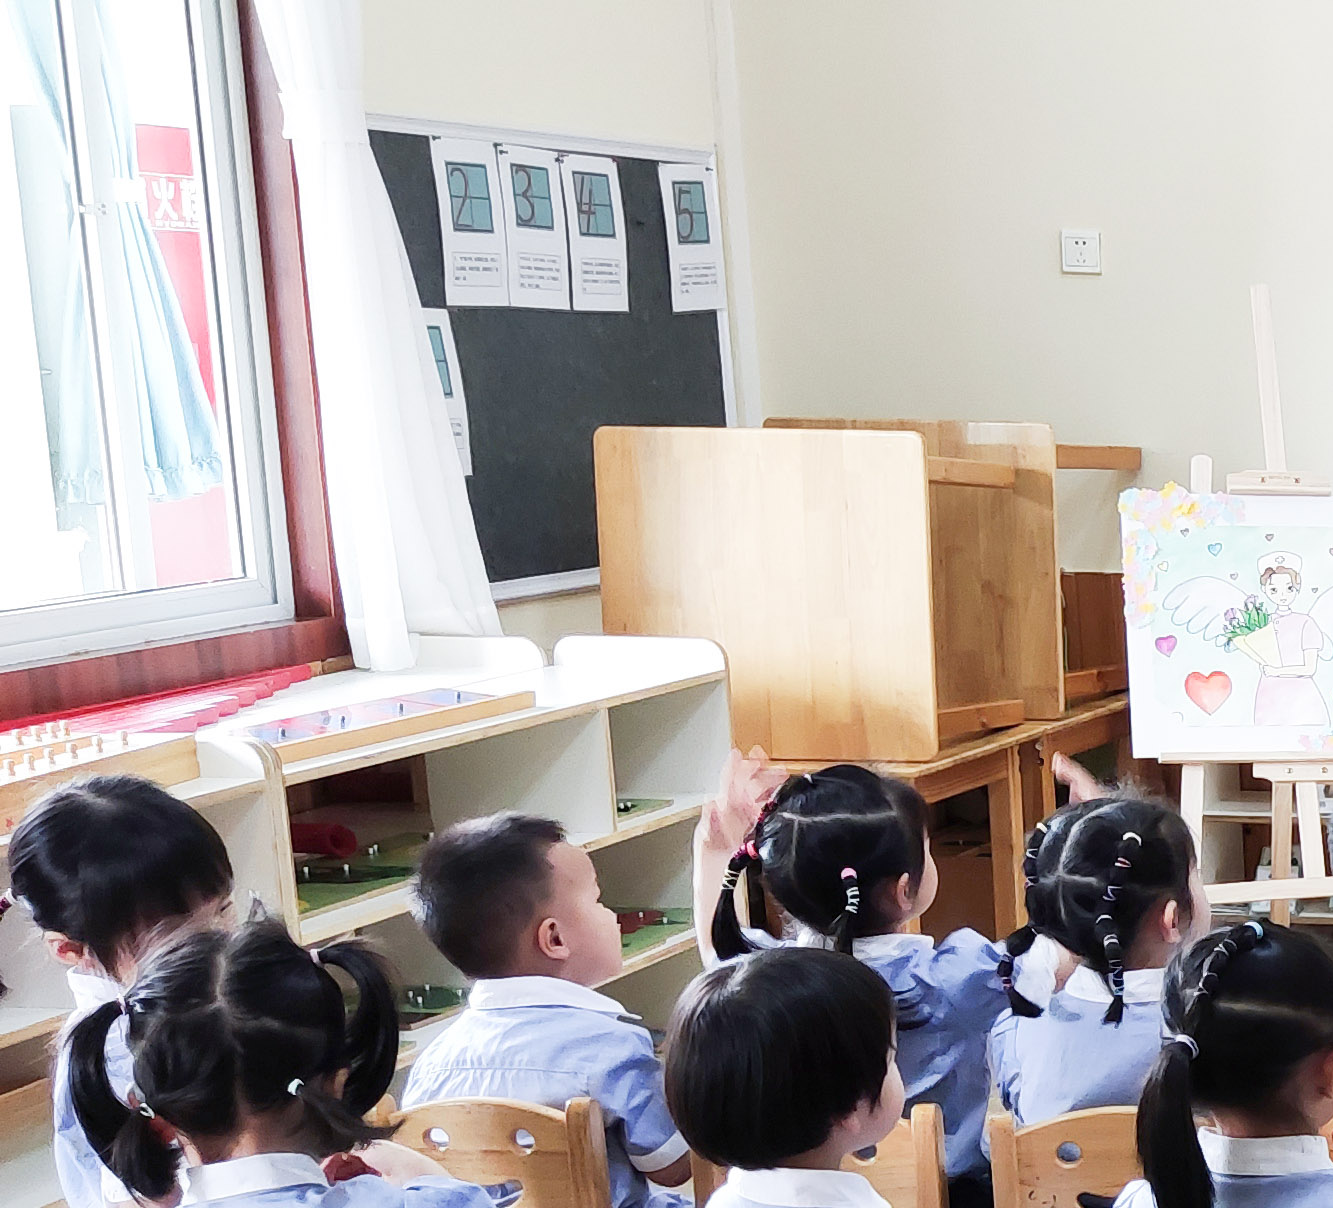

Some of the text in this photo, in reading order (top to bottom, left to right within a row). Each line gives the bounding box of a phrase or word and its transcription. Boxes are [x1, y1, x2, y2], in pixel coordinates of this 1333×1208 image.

[449, 167, 474, 227] 2
[514, 167, 536, 223] 3
[578, 175, 597, 233] 4
[677, 187, 694, 240] 5
